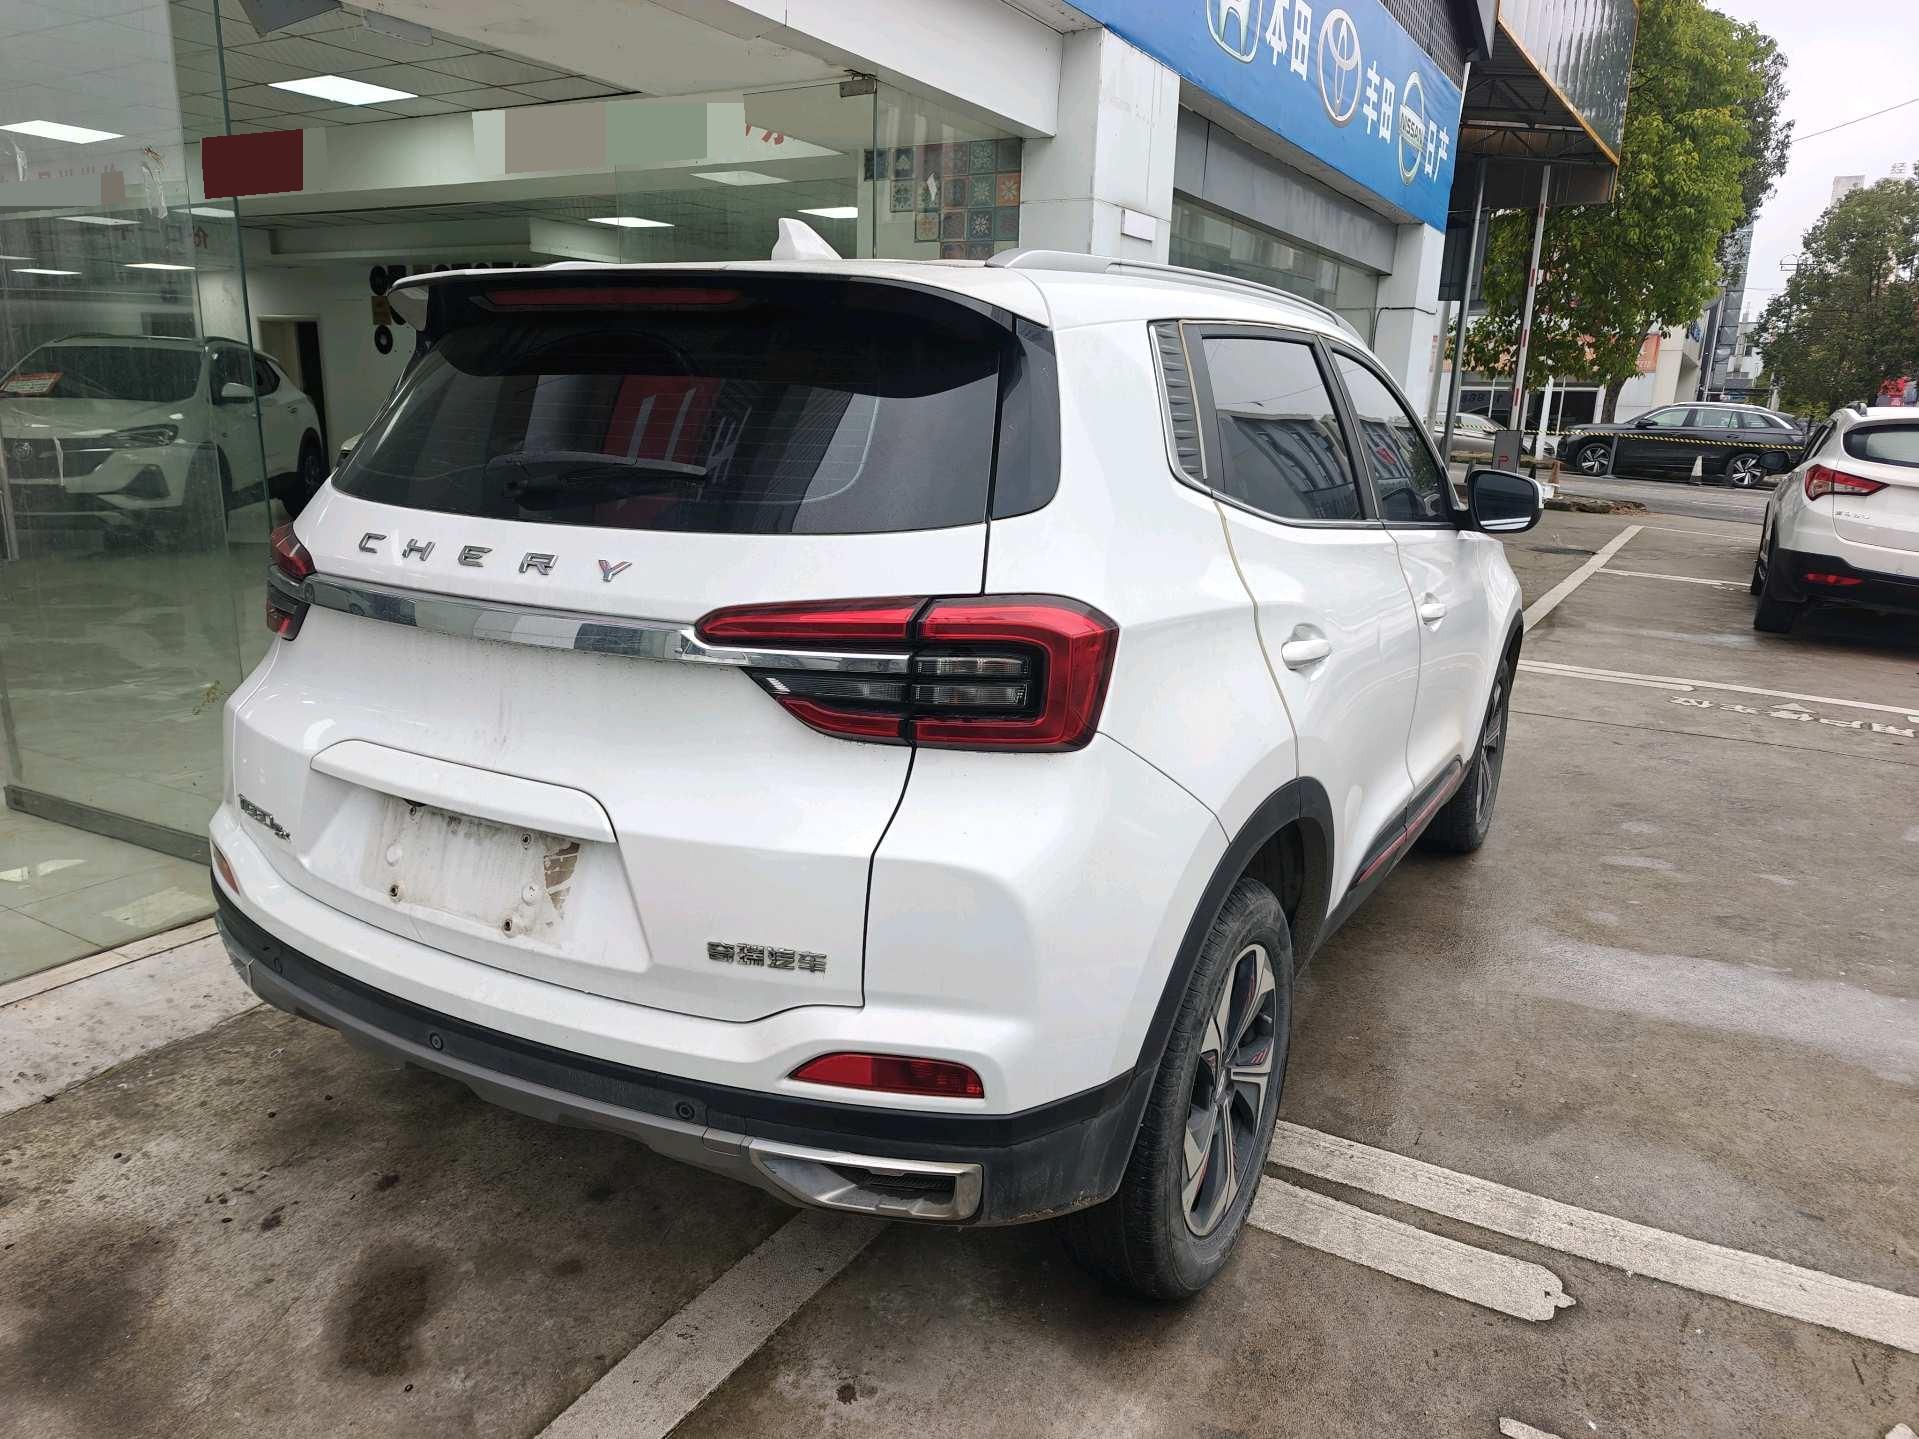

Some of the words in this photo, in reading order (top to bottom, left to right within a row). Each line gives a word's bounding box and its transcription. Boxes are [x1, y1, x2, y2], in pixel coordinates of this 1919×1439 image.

[1265, 0, 1312, 81] 本田
[1363, 60, 1396, 144] 丰田
[1400, 112, 1424, 147] NISSAN
[1424, 119, 1450, 183] 日产
[358, 531, 633, 583] CHERY
[706, 941, 828, 973] 奇瑞汽车
